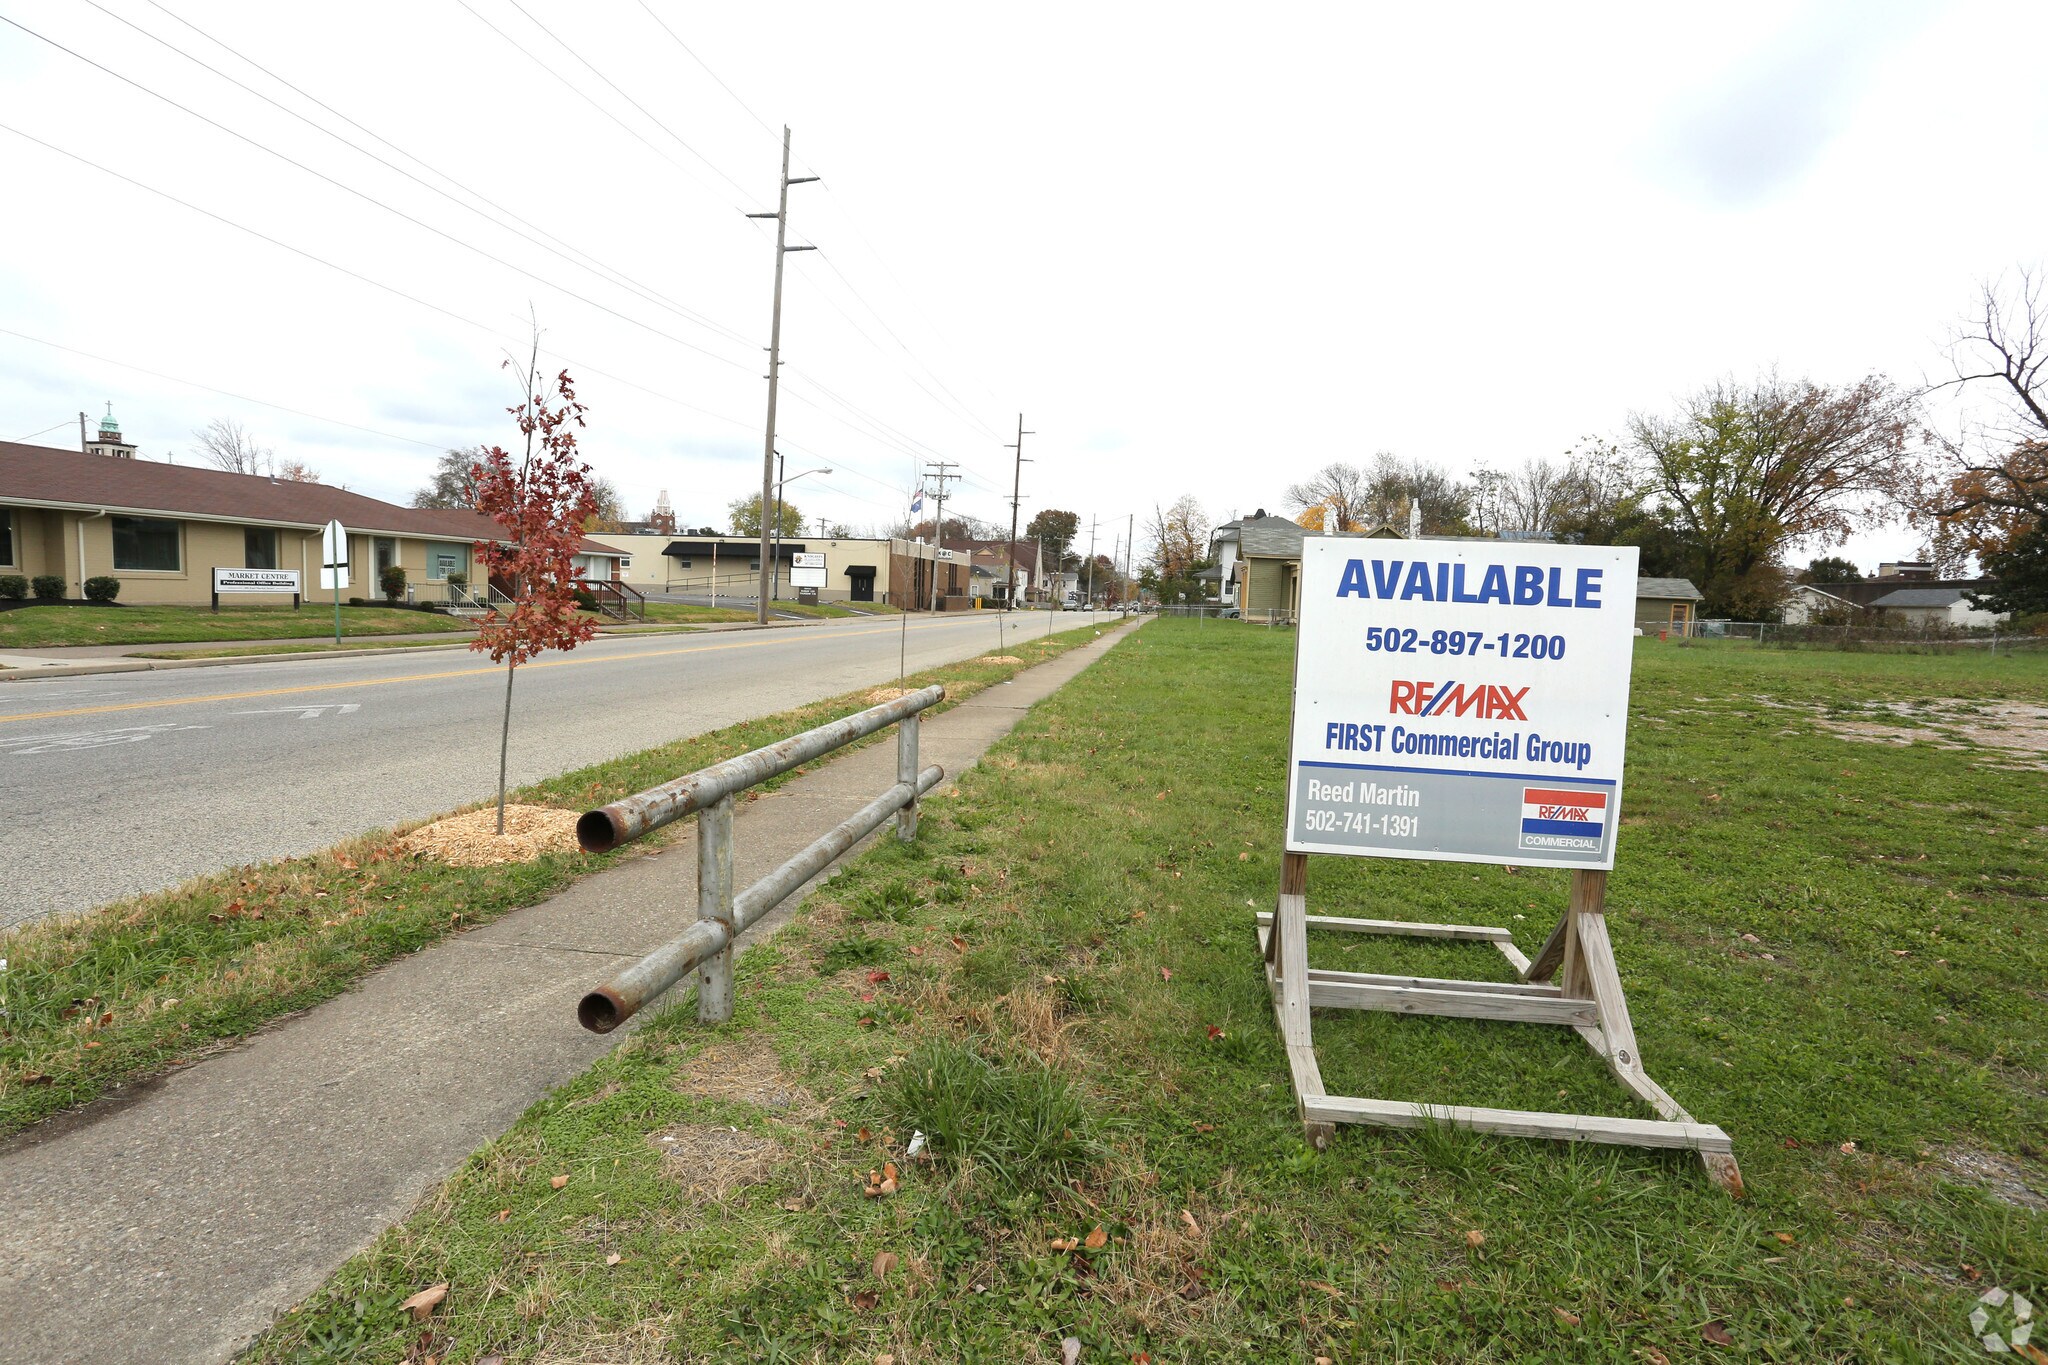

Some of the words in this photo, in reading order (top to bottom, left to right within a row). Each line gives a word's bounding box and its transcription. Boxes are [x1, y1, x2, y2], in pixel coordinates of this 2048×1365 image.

[1336, 559, 1603, 609] AVAILABLE
[1366, 627, 1565, 660] 502-897-1200
[1390, 680, 1530, 720] RE/MAX
[1326, 722, 1385, 752] FIRST
[1391, 726, 1519, 760] Commercial
[1526, 733, 1591, 770] Group
[1308, 779, 1354, 802] Reed
[1359, 782, 1420, 806] Martin
[1305, 809, 1419, 837] 502-741-1391
[1539, 806, 1589, 821] RE/MAX
[1525, 836, 1596, 849] COMMERCIAL
